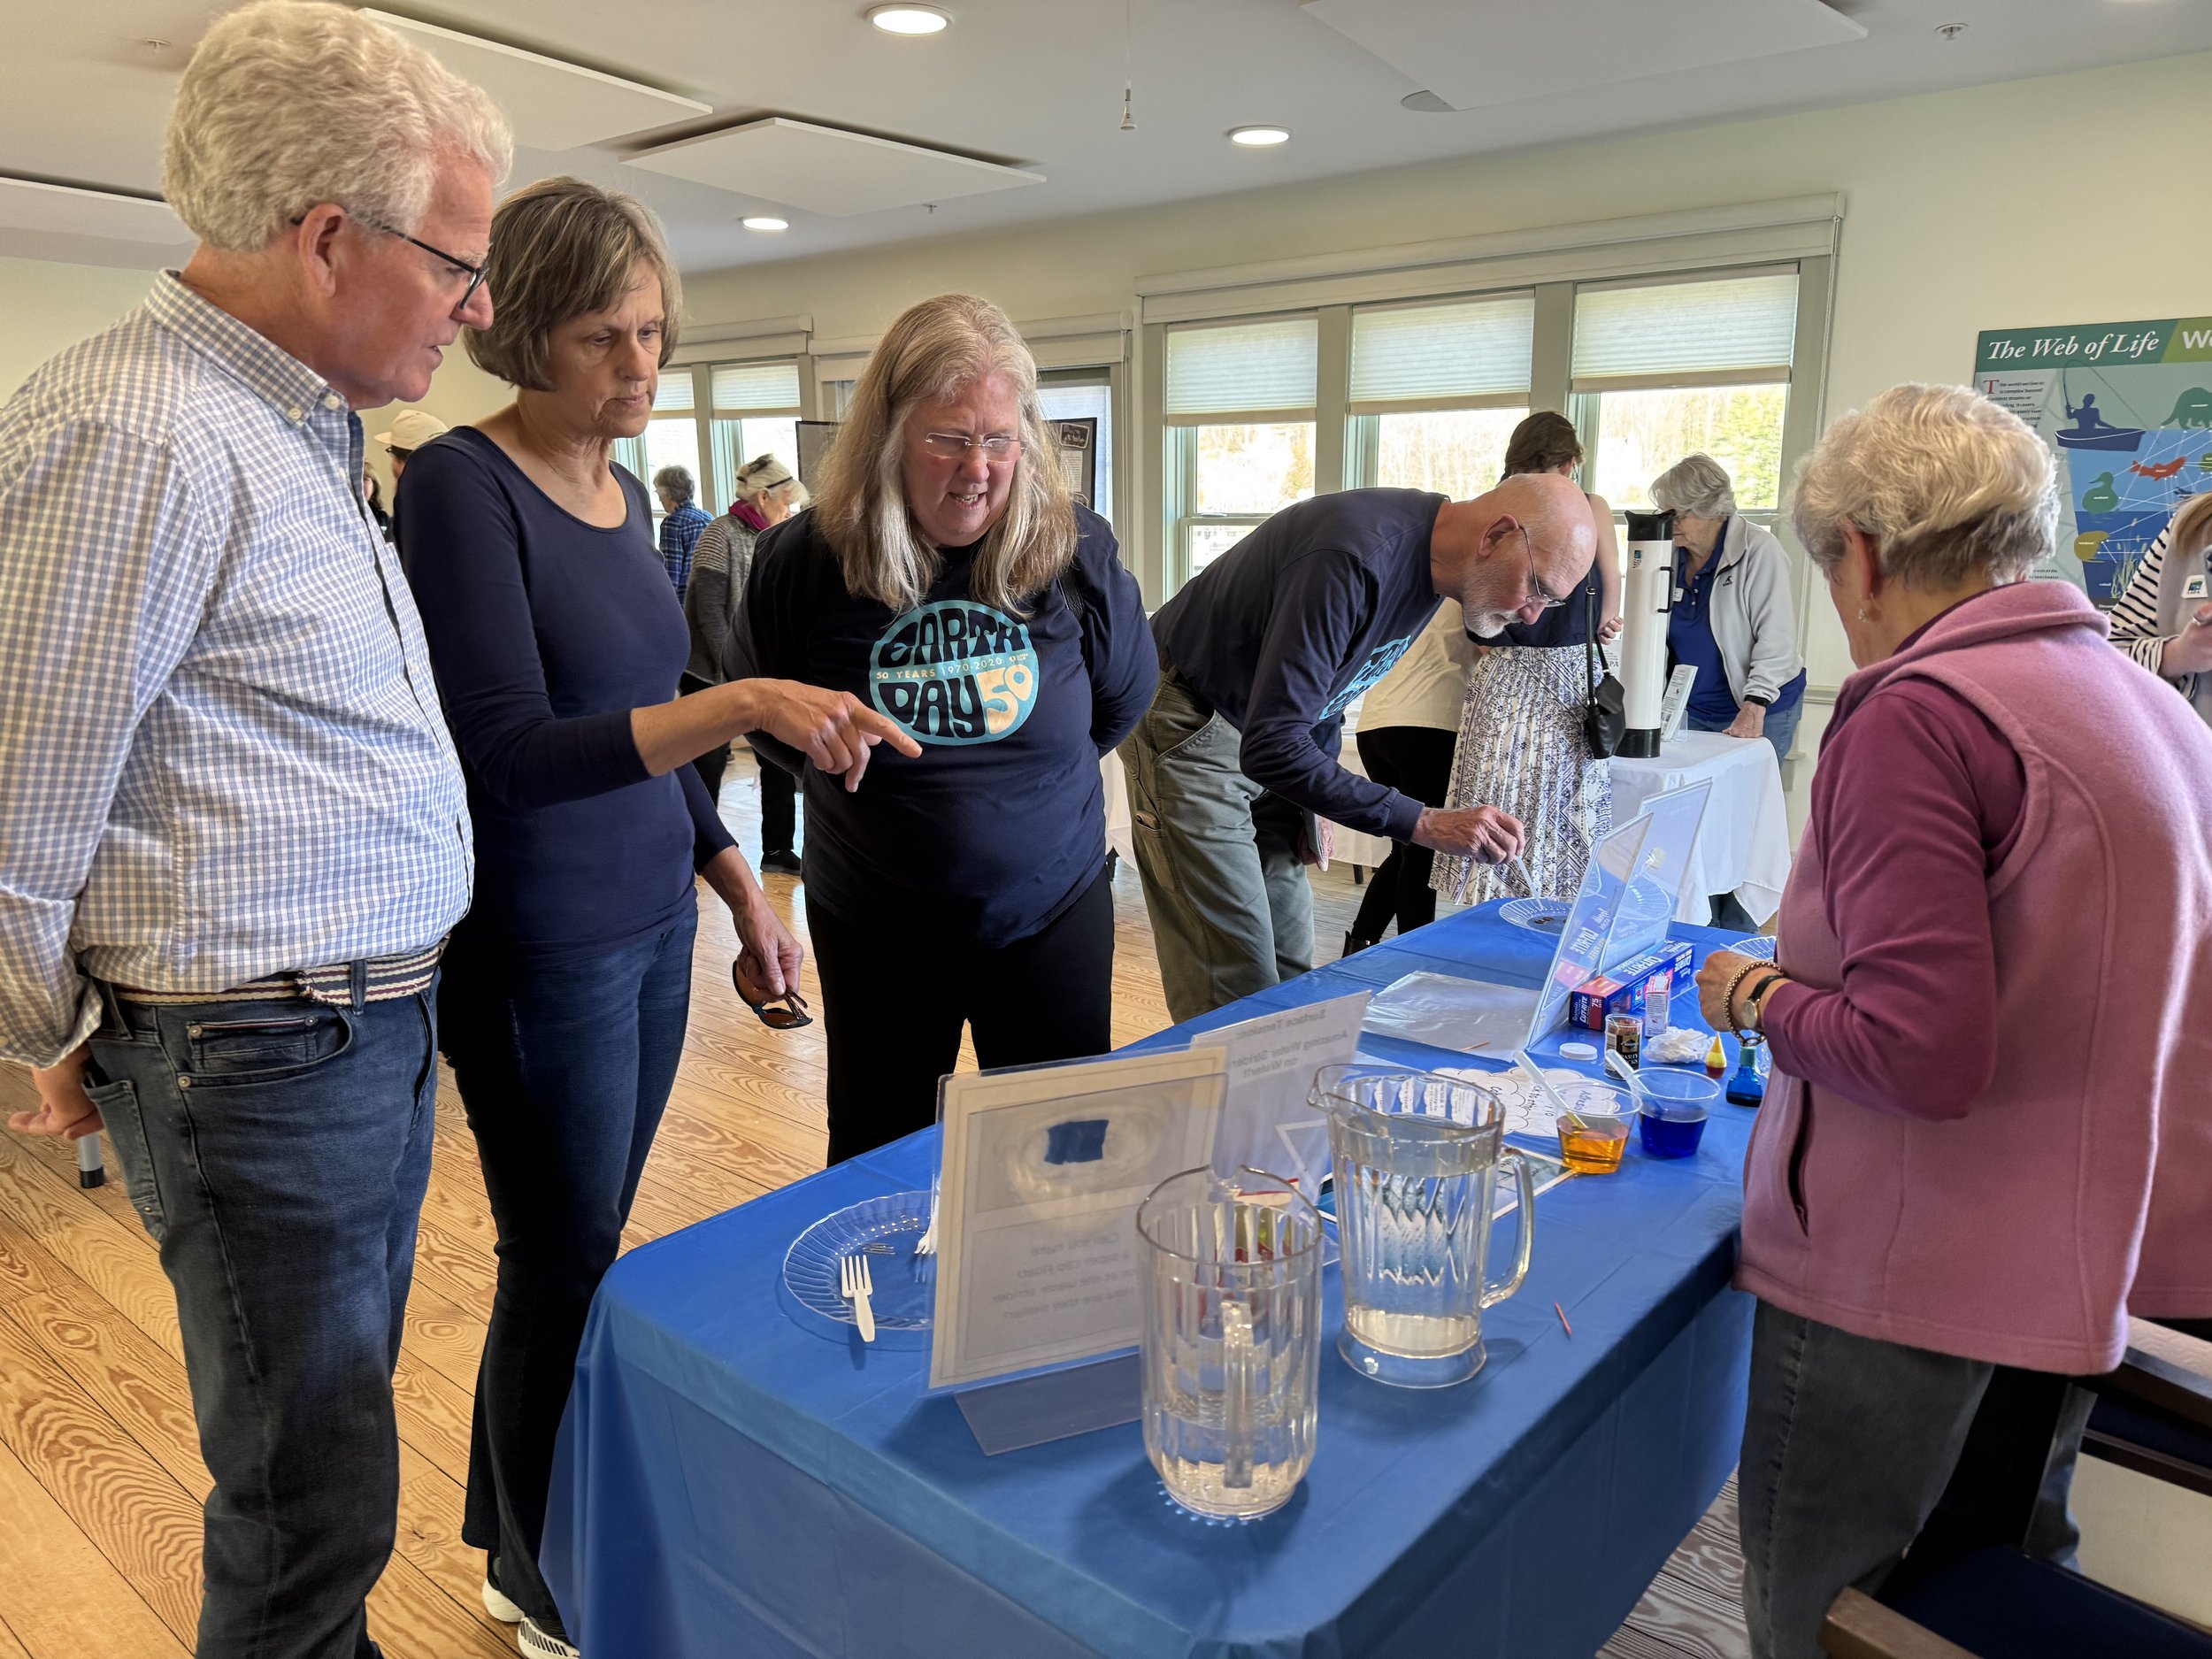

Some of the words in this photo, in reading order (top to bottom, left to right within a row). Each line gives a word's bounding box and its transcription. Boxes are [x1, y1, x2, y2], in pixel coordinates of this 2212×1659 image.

[1987, 339, 2026, 360] The
[2032, 335, 2079, 357] Web
[2084, 333, 2114, 361] of
[2110, 330, 2160, 359] Life
[878, 608, 1026, 668] EARTH
[876, 671, 889, 680] 50
[896, 668, 936, 679] YEARS
[878, 673, 987, 739] DAY
[976, 664, 1033, 734] 50
[1579, 995, 1588, 1023] CUT-RITE
[1591, 997, 1599, 1008] 75
